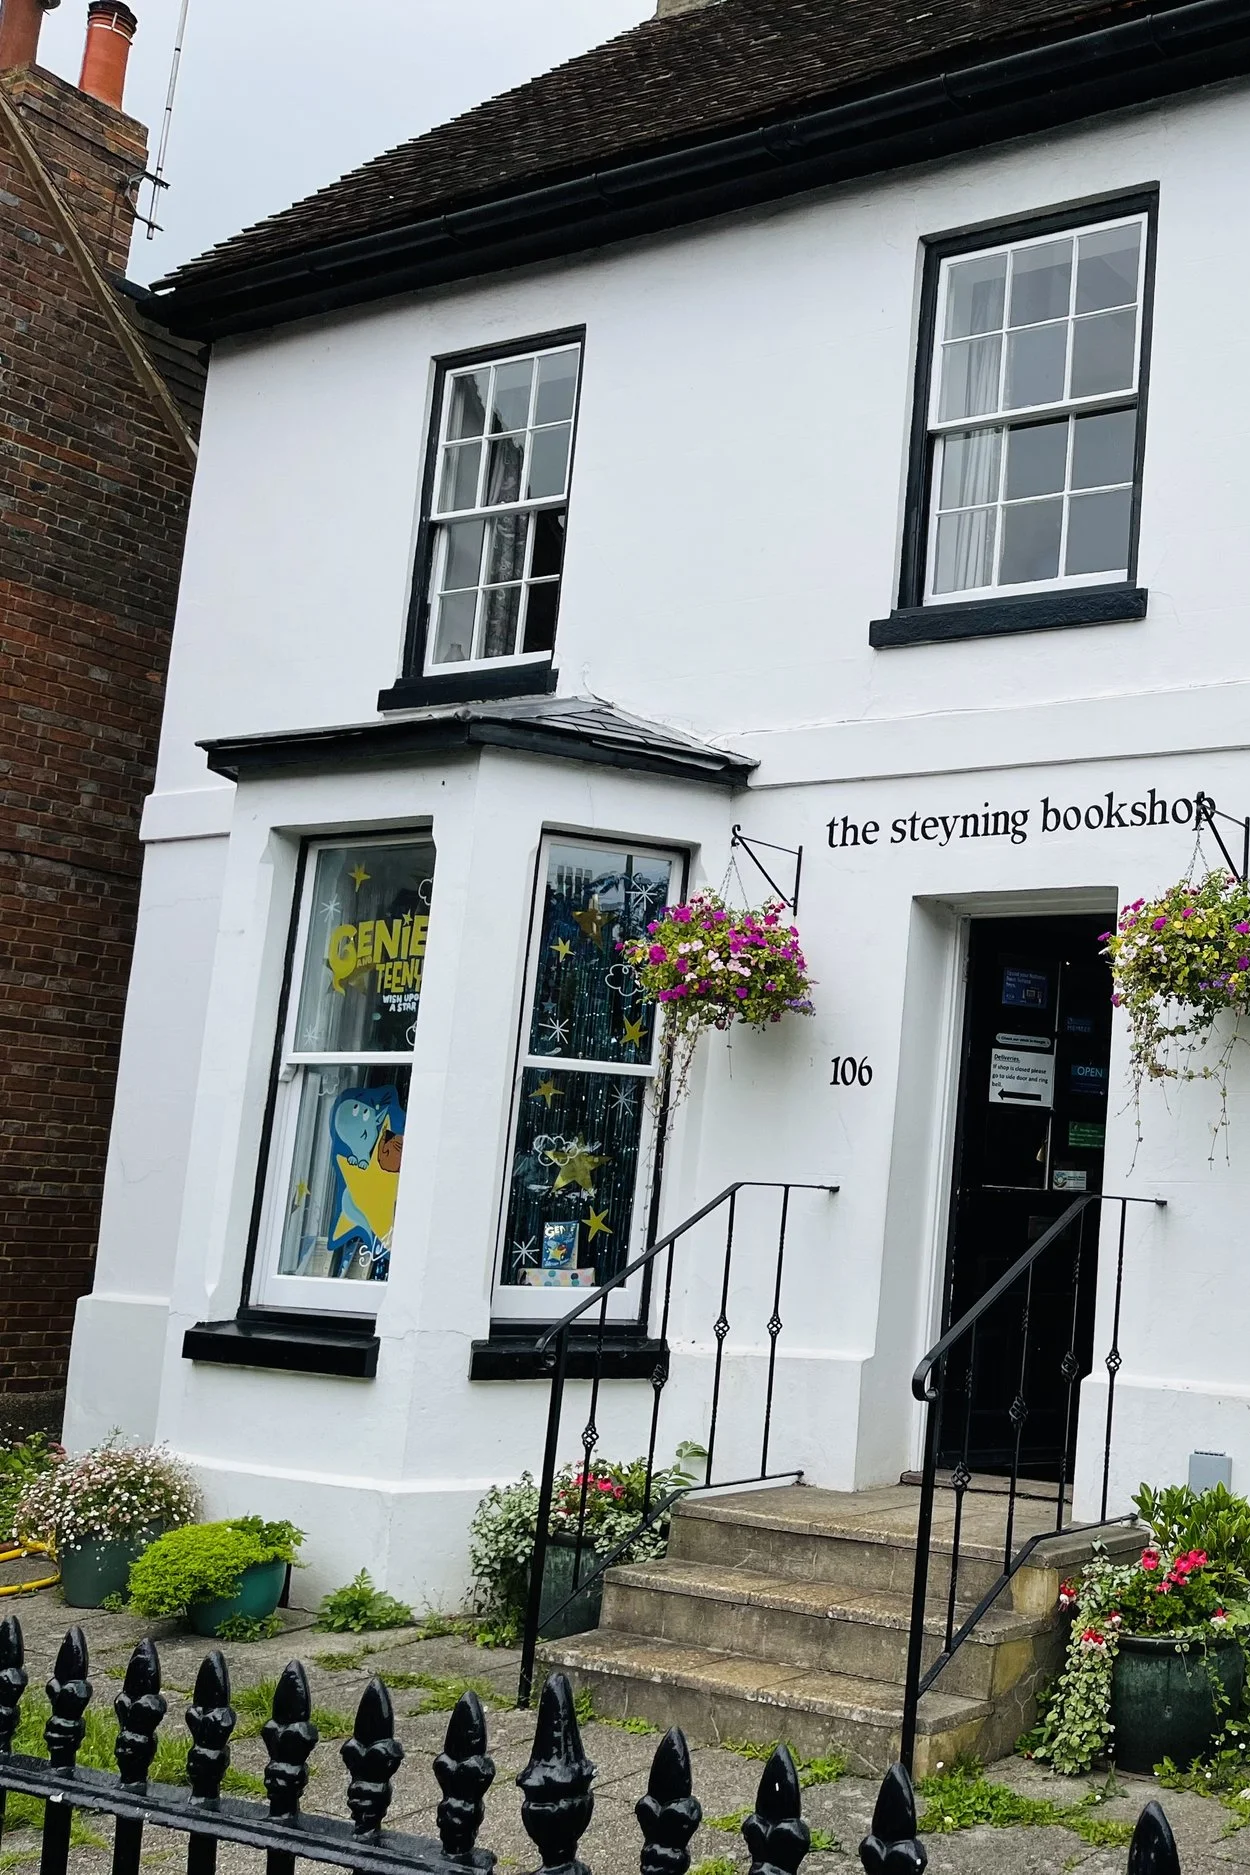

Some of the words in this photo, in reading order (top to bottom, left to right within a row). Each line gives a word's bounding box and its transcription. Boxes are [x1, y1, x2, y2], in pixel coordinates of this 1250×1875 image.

[826, 814, 880, 848] the
[890, 801, 1030, 847] steyning
[1040, 787, 1216, 833] bookshop
[357, 956, 372, 967] AND
[383, 994, 403, 1003] WISH
[404, 993, 420, 1003] UPO
[389, 1004, 396, 1012] A
[397, 1002, 417, 1012] STAR
[829, 1056, 873, 1087] 106
[1077, 1066, 1103, 1077] OPEN
